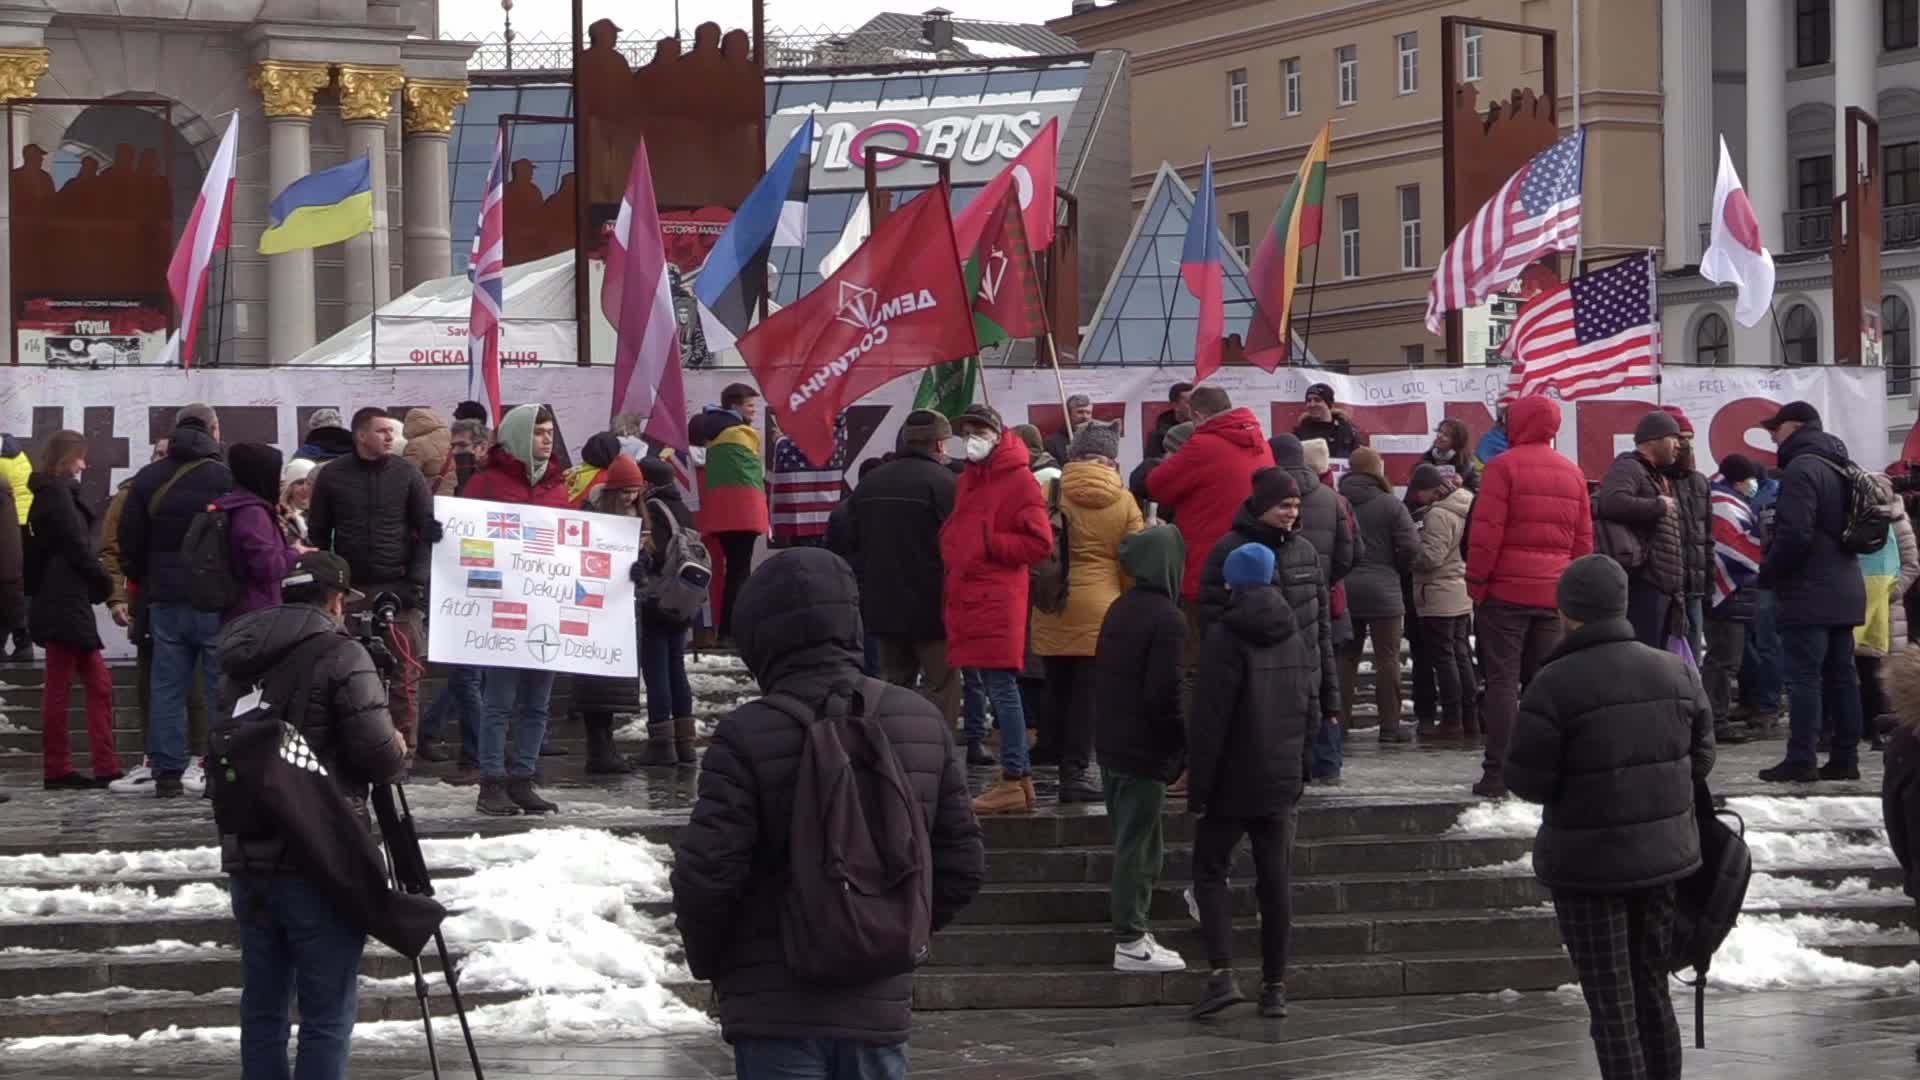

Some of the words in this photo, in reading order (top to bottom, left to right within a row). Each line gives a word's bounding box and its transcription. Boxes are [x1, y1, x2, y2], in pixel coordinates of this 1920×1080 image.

[1360, 380, 1394, 401] You
[511, 552, 545, 575] Thank
[547, 562, 571, 581] you
[464, 629, 517, 652] Paldies
